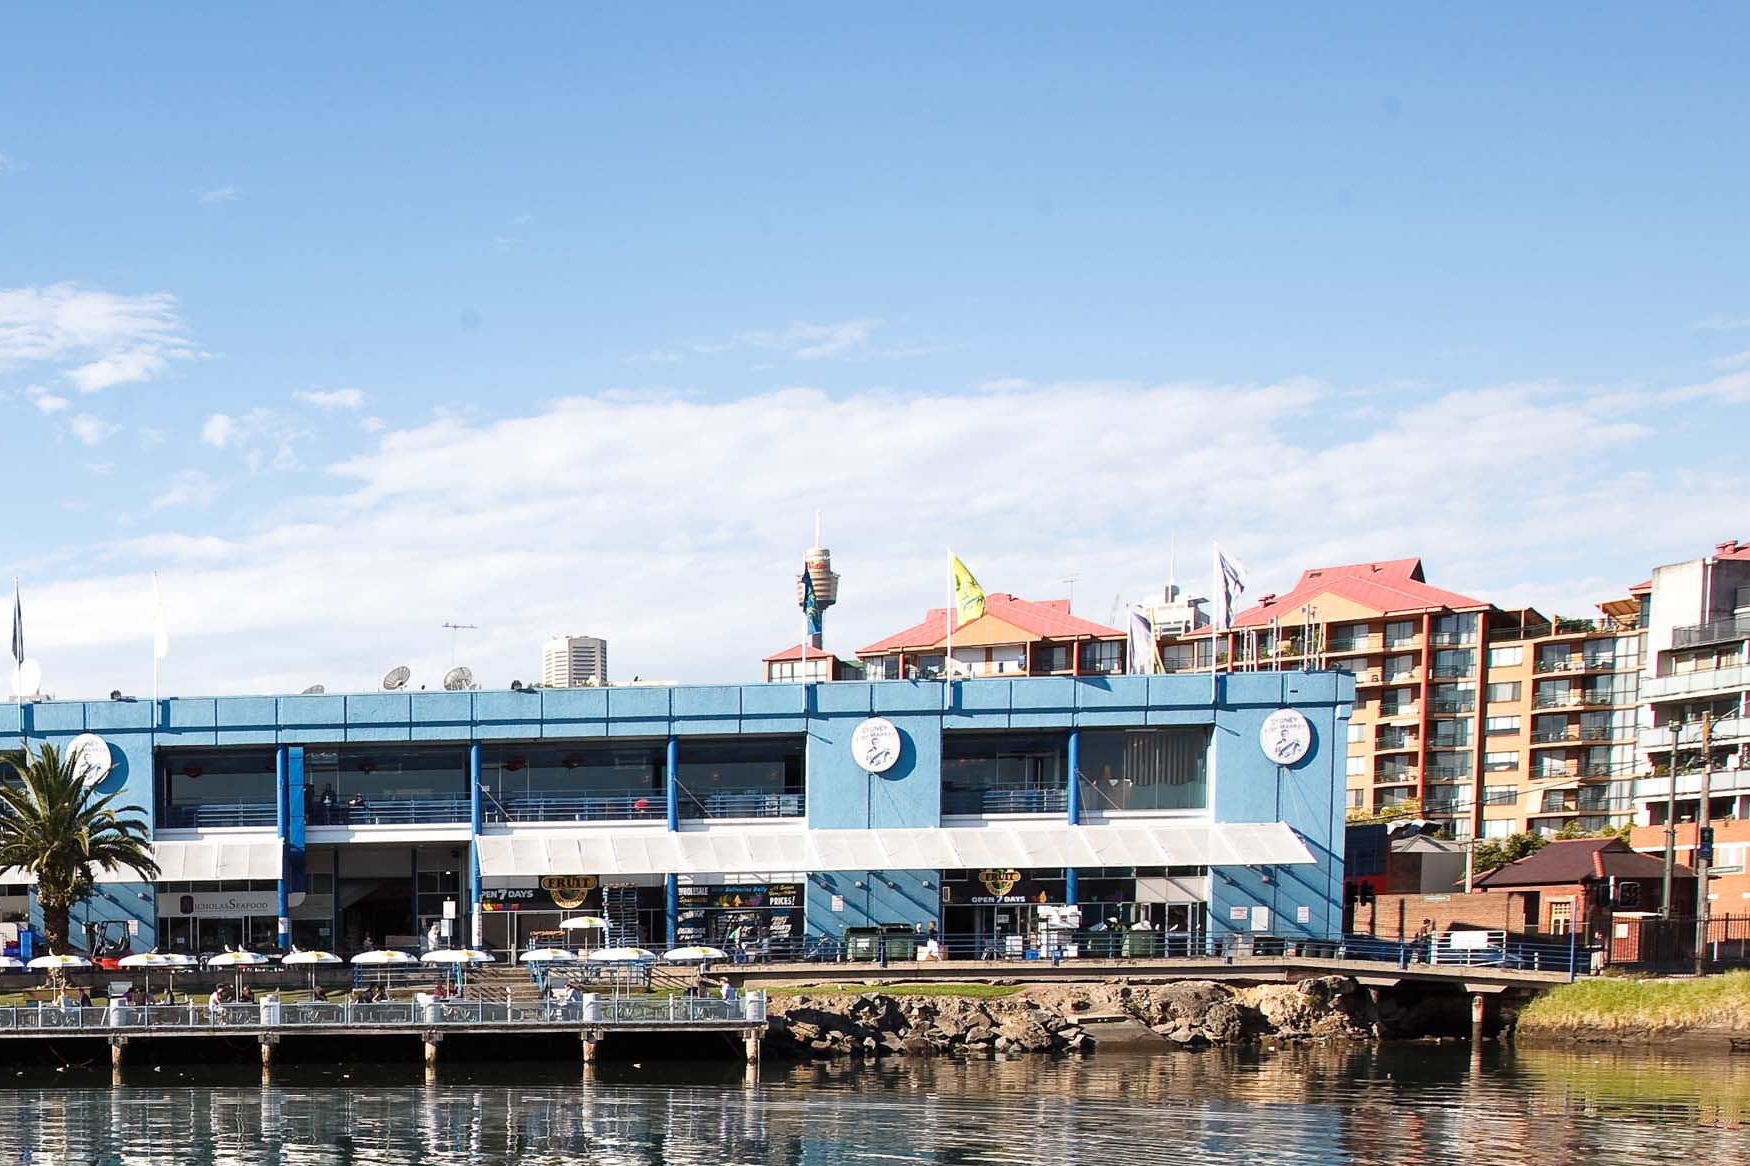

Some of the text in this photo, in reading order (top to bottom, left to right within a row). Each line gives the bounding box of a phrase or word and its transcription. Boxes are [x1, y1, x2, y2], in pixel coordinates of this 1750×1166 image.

[986, 872, 1013, 880] FRUIT
[549, 878, 591, 888] FRUIT
[498, 889, 507, 900] 7
[508, 890, 534, 898] DAYS
[678, 887, 708, 896] WHOLESALE
[769, 895, 796, 906] PRICES!
